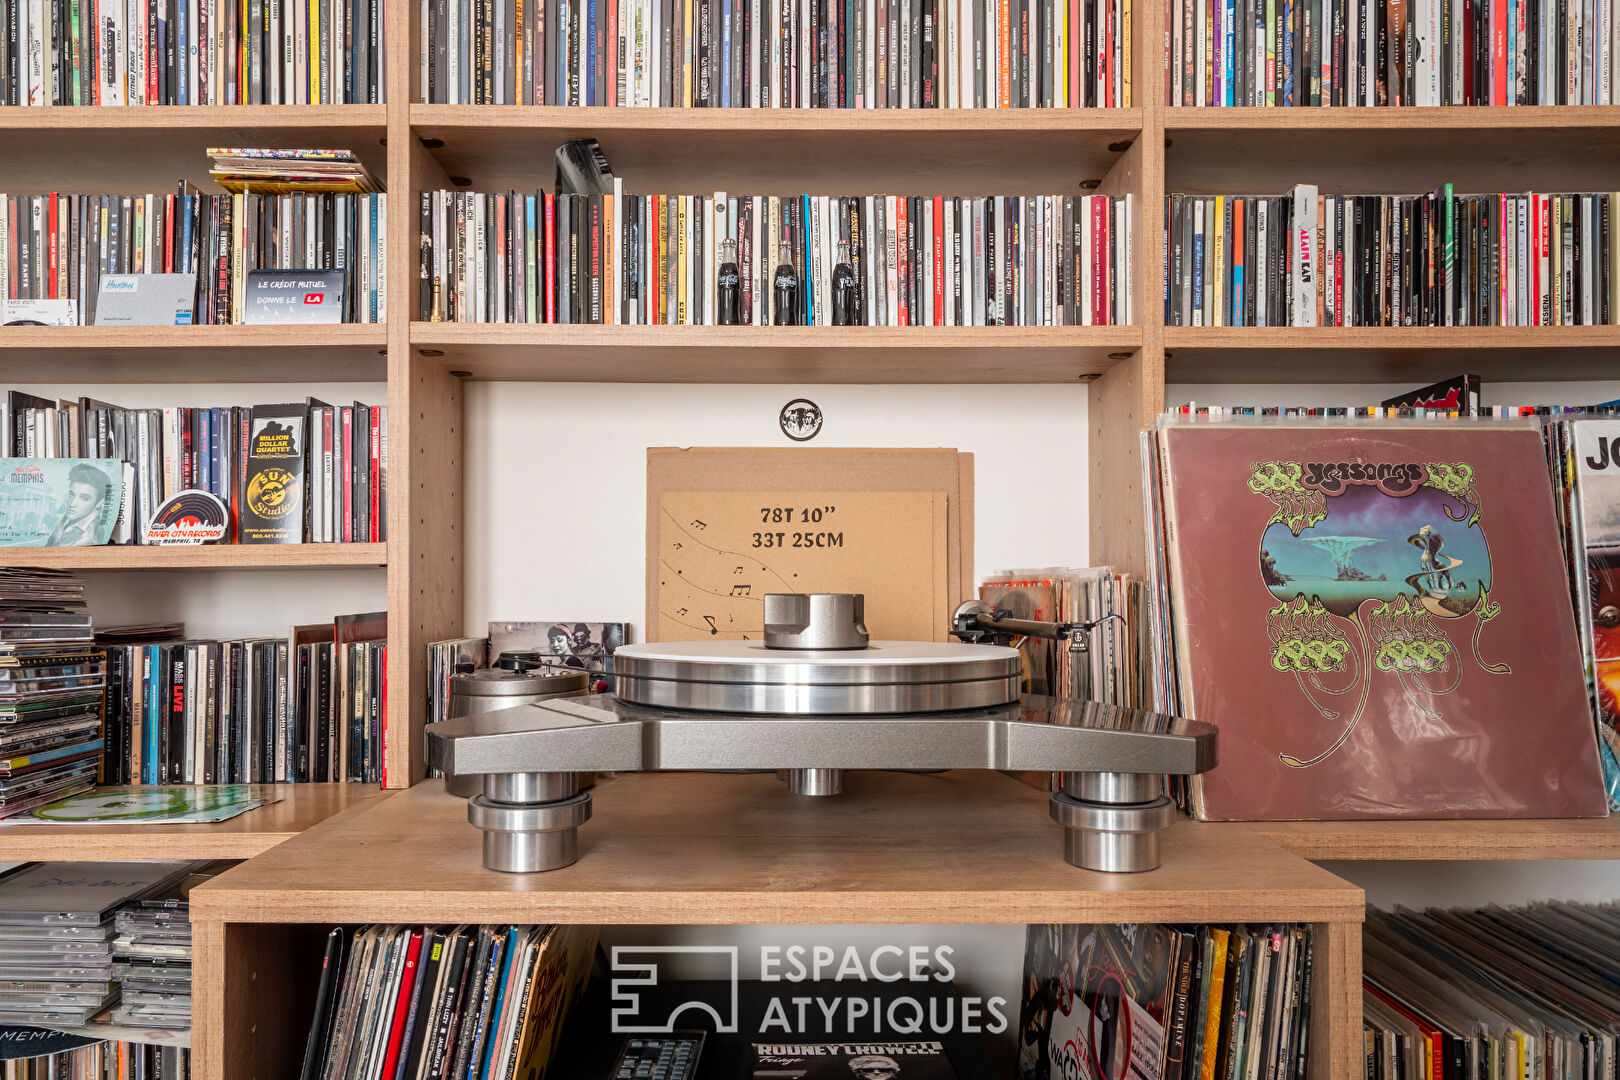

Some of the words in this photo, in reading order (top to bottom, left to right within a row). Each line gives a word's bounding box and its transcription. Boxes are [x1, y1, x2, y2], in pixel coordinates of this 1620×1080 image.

[1300, 229, 1310, 260] ALAIN
[459, 254, 464, 263] DU
[1301, 262, 1311, 283] KAN
[270, 280, 297, 288] CRÉDIT
[11, 473, 44, 483] MEMPHIS
[259, 471, 295, 485] SUN
[1305, 462, 1423, 492] yessongs
[255, 502, 291, 515] Studio
[760, 508, 793, 523] 78T
[752, 532, 785, 548] 33T
[792, 532, 843, 548] 25CM
[174, 686, 184, 712] LIVE
[1175, 996, 1187, 1047] DOPAMINE
[433, 1036, 444, 1073] JAILBREAK
[758, 1045, 839, 1055] RODNEY
[844, 1043, 941, 1055] CROWELL
